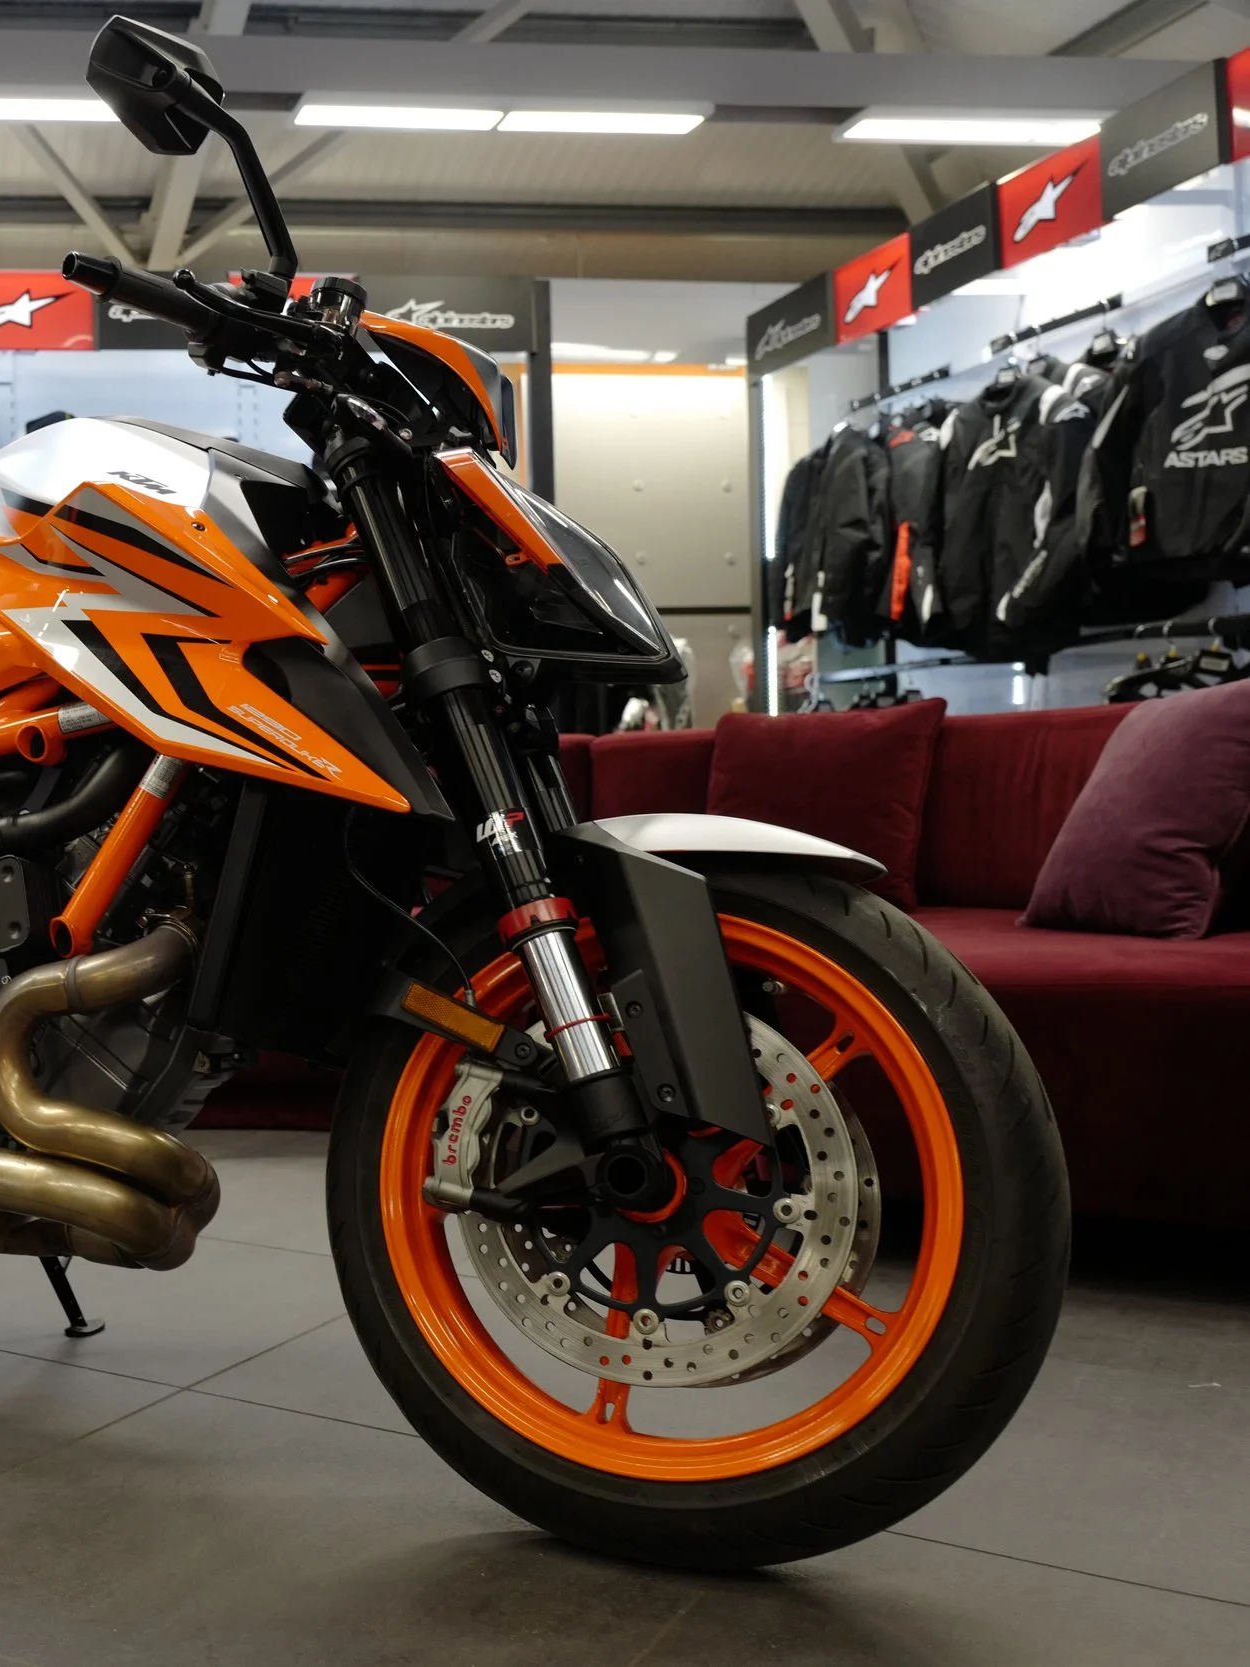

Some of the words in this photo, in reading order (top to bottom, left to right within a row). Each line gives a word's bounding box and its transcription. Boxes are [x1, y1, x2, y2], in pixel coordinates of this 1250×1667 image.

[1163, 446, 1248, 469] ASTARS
[106, 471, 178, 495] KTM
[442, 1095, 472, 1166] brembo
